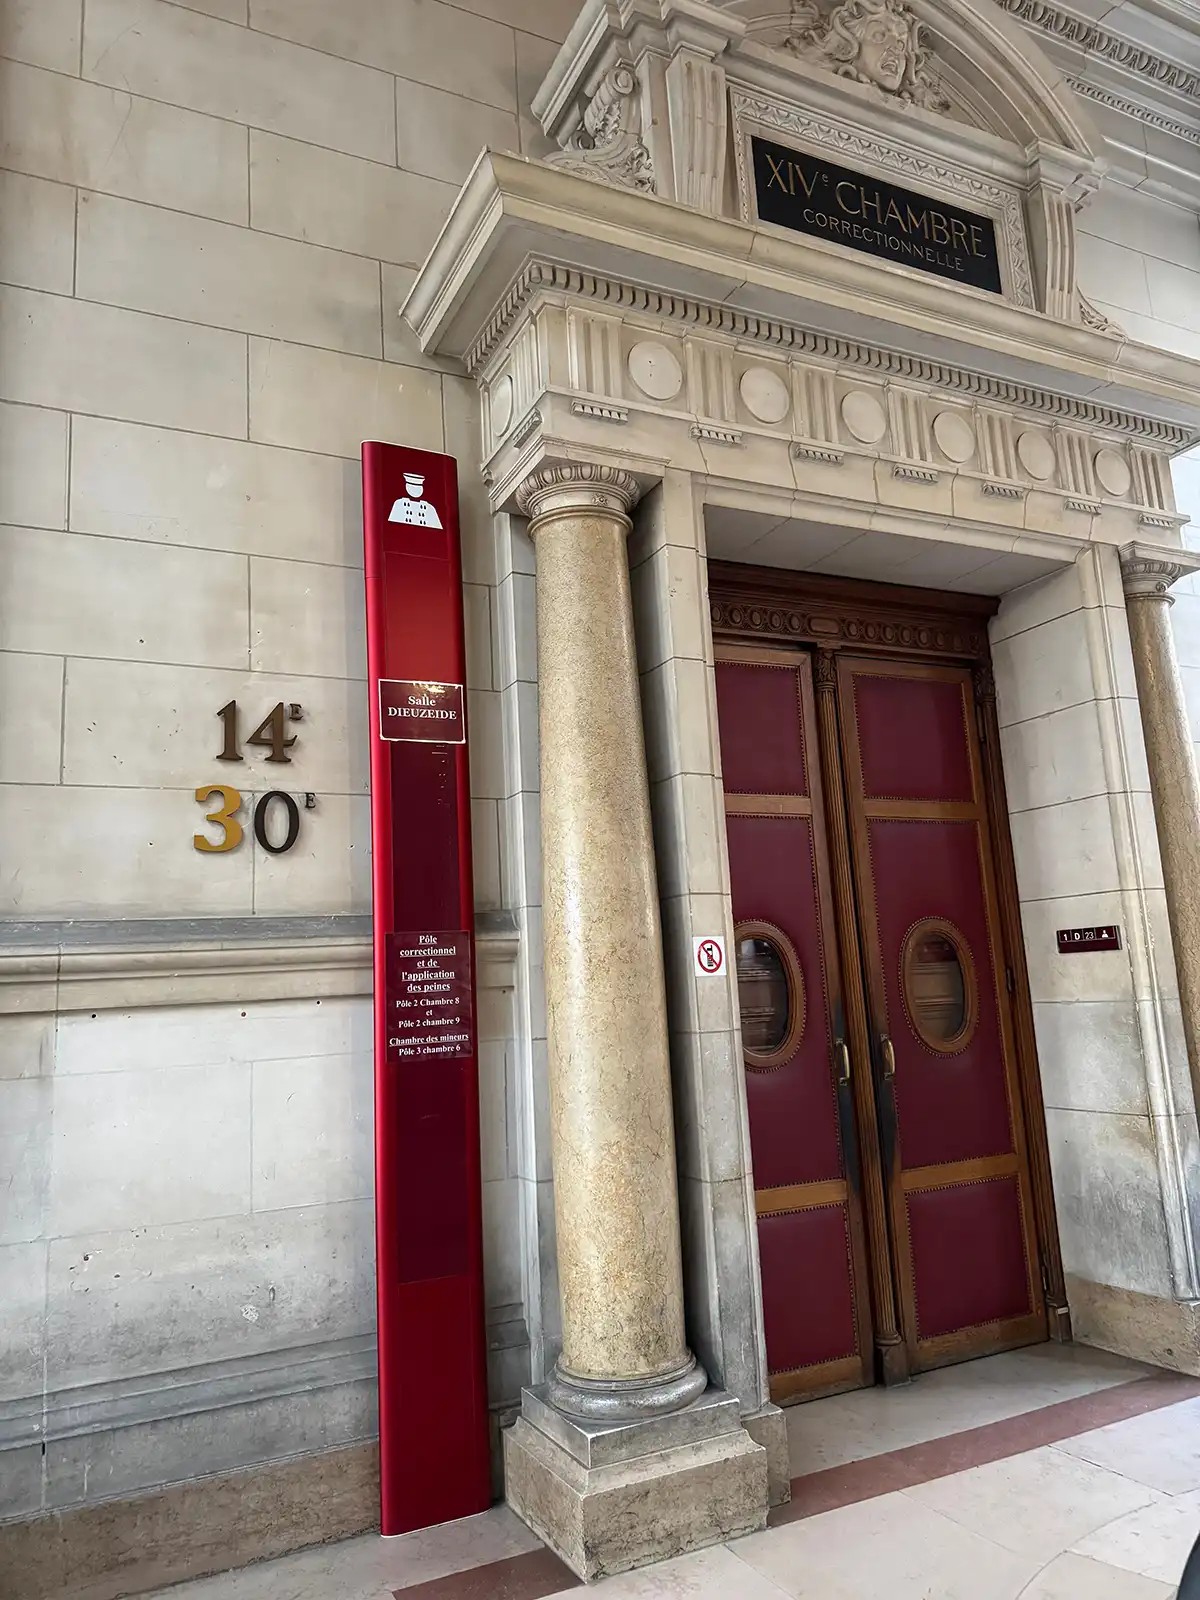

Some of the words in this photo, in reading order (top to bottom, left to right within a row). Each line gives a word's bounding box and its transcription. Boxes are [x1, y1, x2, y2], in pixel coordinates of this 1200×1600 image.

[836, 181, 987, 258] CHAMBRE
[803, 208, 964, 272] CORRECTIONNELLE
[408, 694, 436, 706] Salle
[388, 707, 457, 720] DIEUZEIDE
[419, 935, 438, 944] Pôle
[400, 946, 456, 957] correctionnel
[417, 960, 425, 968] et
[427, 959, 438, 967] de
[402, 970, 455, 981] l'application
[407, 984, 421, 992] des
[424, 982, 451, 993] peines
[396, 1000, 412, 1008] Pôle
[420, 998, 453, 1006] Chambre
[398, 1020, 414, 1028] Pôle
[422, 1018, 454, 1026] chambre
[389, 1037, 424, 1046] Chambre
[426, 1035, 438, 1043] des
[440, 1033, 469, 1042] mineurs
[399, 1048, 415, 1056] Pôle
[422, 1045, 454, 1054] chambre
